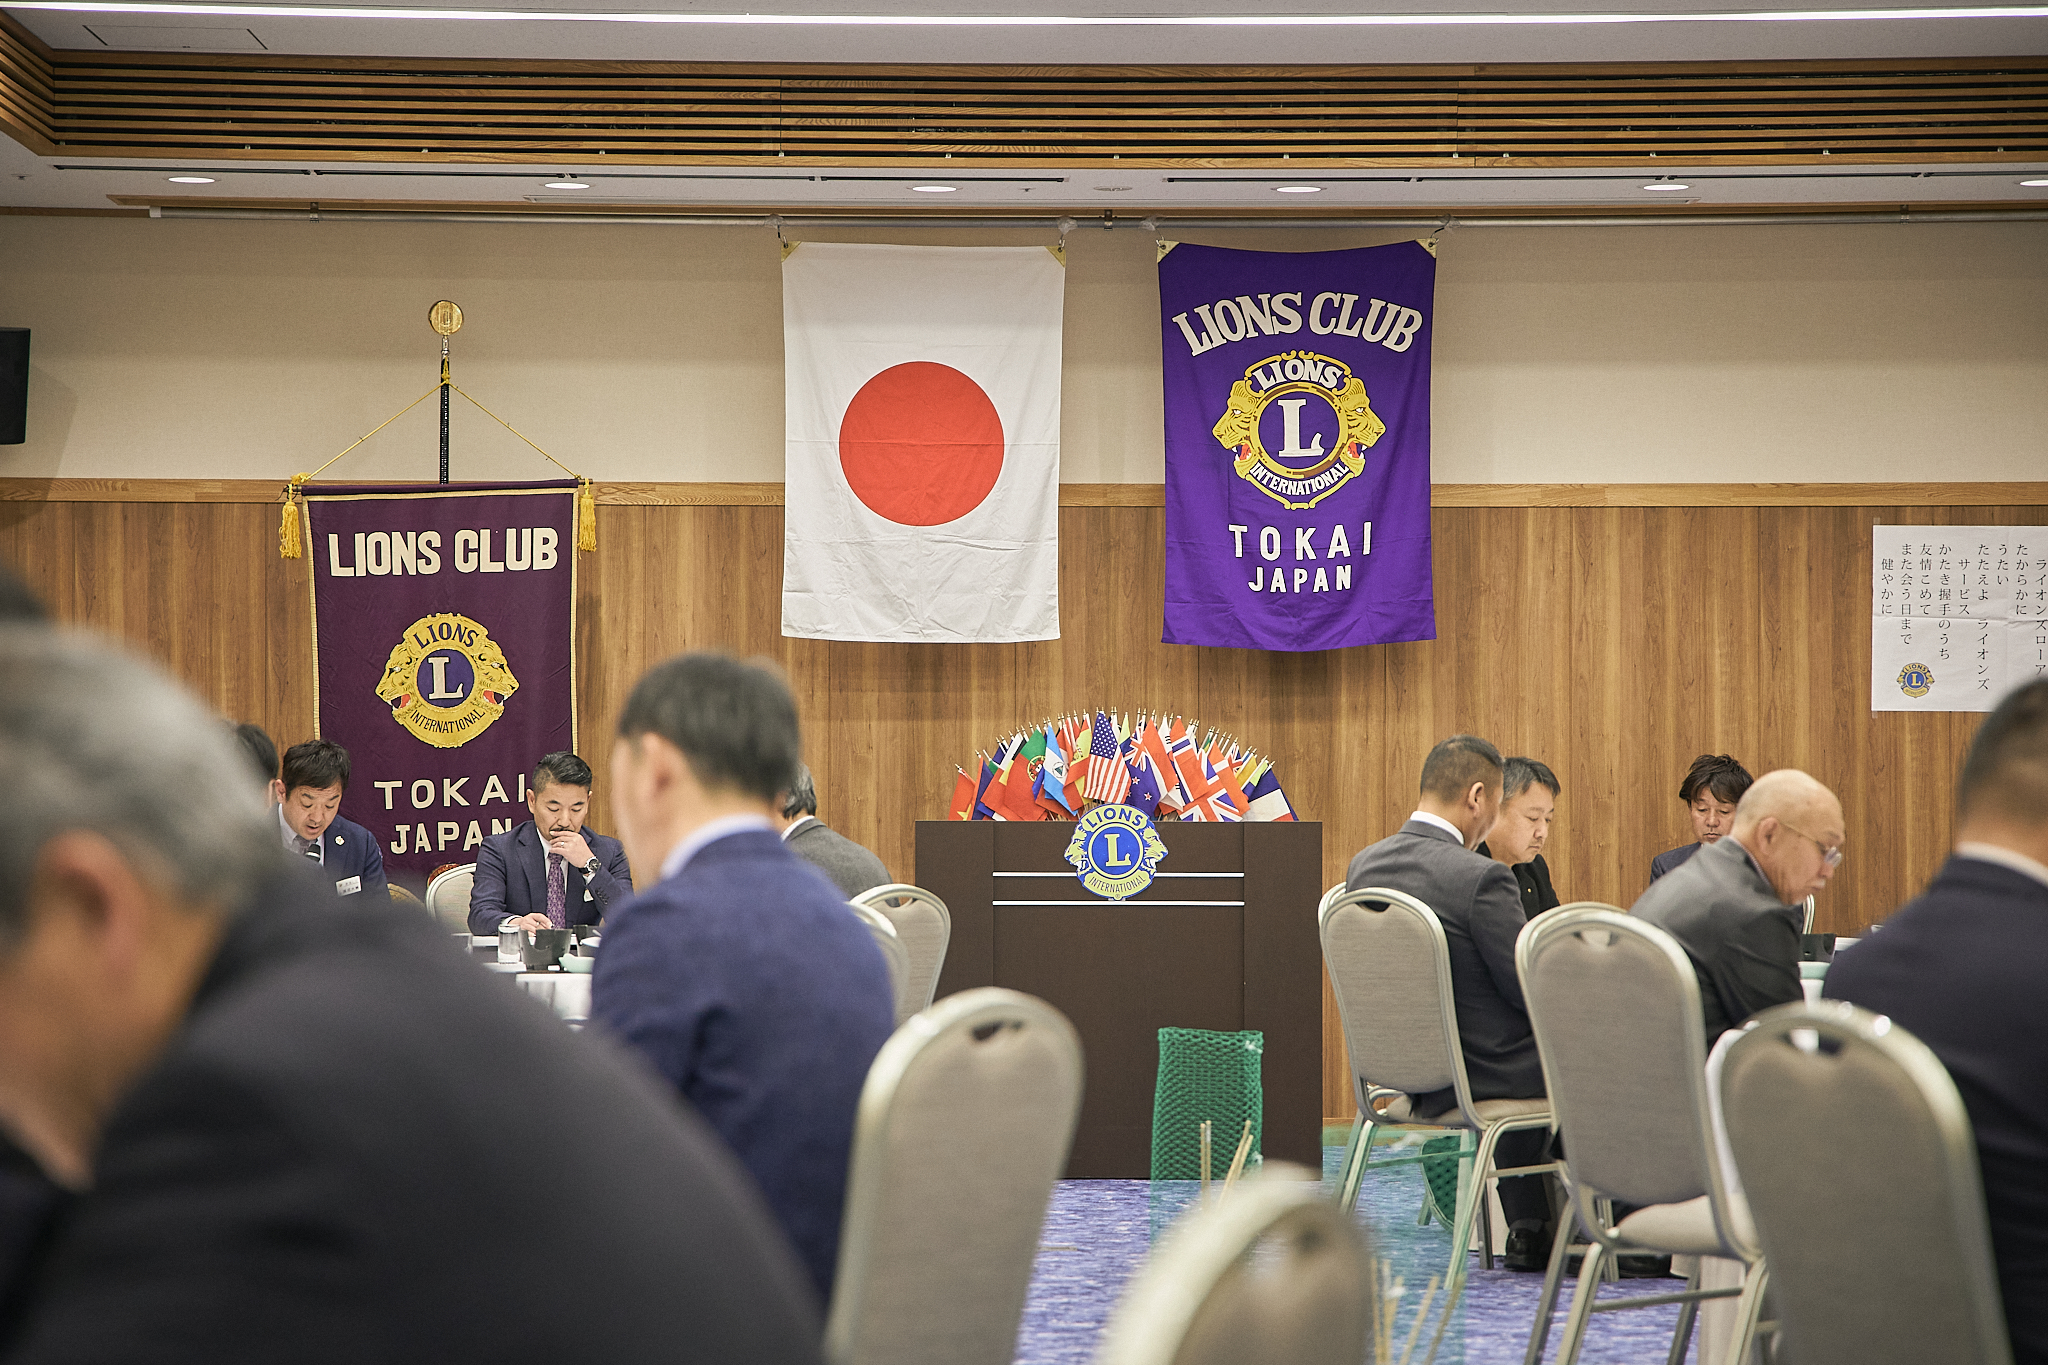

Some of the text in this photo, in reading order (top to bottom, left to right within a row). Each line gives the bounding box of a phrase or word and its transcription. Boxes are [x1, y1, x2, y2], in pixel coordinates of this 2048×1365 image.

[1172, 291, 1423, 357] LIONS CLUB
[1252, 358, 1343, 391] LIONS
[1277, 399, 1325, 458] L
[1250, 463, 1350, 497] INTERNATIONAL
[328, 527, 559, 578] LIONS CLUB
[1228, 521, 1373, 562] TOKAI
[1248, 565, 1353, 594] JAPAN
[1919, 543, 1932, 615] 友情こめて
[1997, 544, 2009, 586] うたい
[2015, 544, 2028, 615] たからかに
[1881, 558, 1894, 615] 健やかに
[1900, 543, 1913, 646] また会う日まで
[1958, 559, 1971, 616] サービス
[413, 622, 479, 650] LIONS
[1977, 544, 1990, 691] たたえよ ライオンズ
[427, 656, 464, 700] L
[1911, 673, 1921, 686] L
[409, 708, 486, 734] INTERNATIONAL
[373, 773, 526, 810] TOKAI
[390, 818, 513, 855] JAPAN
[1086, 808, 1143, 828] LIONS
[1104, 833, 1131, 867] L
[1088, 875, 1146, 893] INTERNATIONAL
